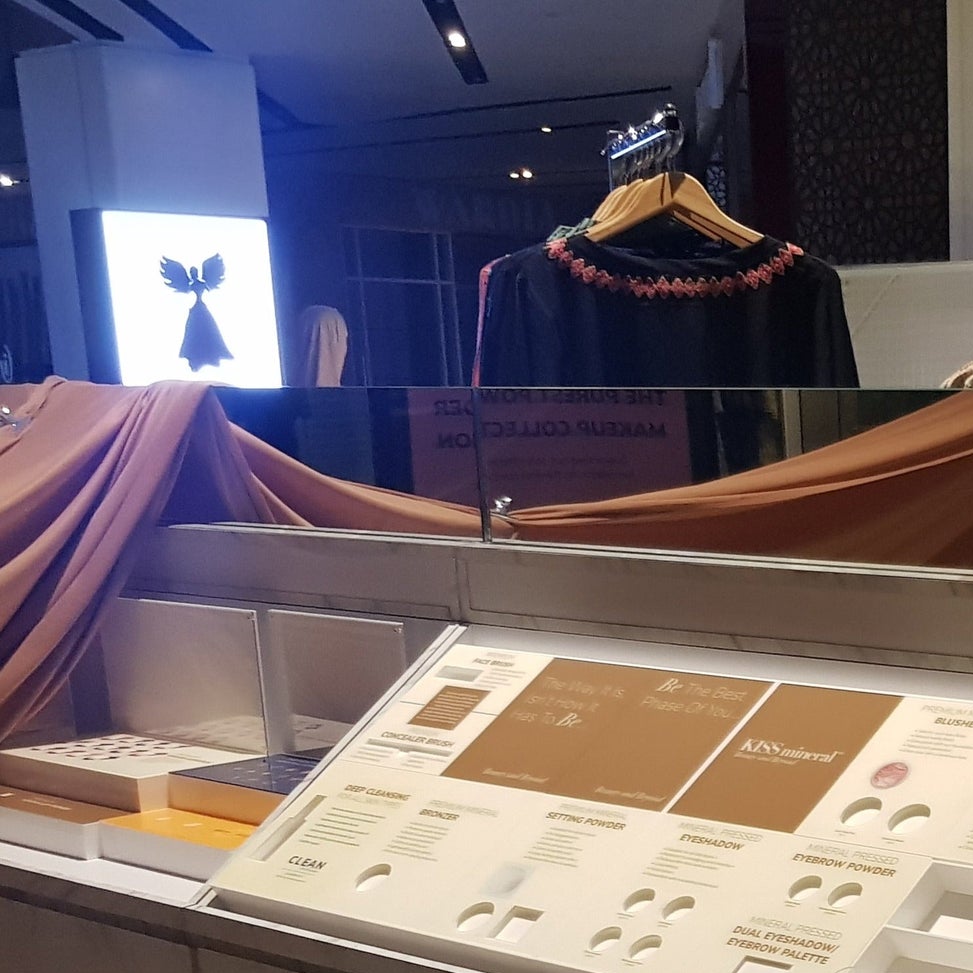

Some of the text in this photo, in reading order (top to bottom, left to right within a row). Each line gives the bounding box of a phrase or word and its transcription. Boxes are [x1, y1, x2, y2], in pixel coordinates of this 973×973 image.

[344, 784, 367, 793] DEEP
[365, 788, 412, 801] CLEANSING
[418, 808, 460, 821] BRONZER
[545, 811, 627, 831] SETTING POWDER
[679, 833, 745, 851] EYESHADOW
[288, 855, 328, 870] CLEAN
[792, 853, 897, 878] EYEBROW POWDER
[852, 850, 900, 866] PRESSED
[732, 925, 841, 954] DUAL EYESHADOW/
[796, 924, 843, 941] PRESSED
[726, 937, 831, 965] EYEBROW PALETTE
